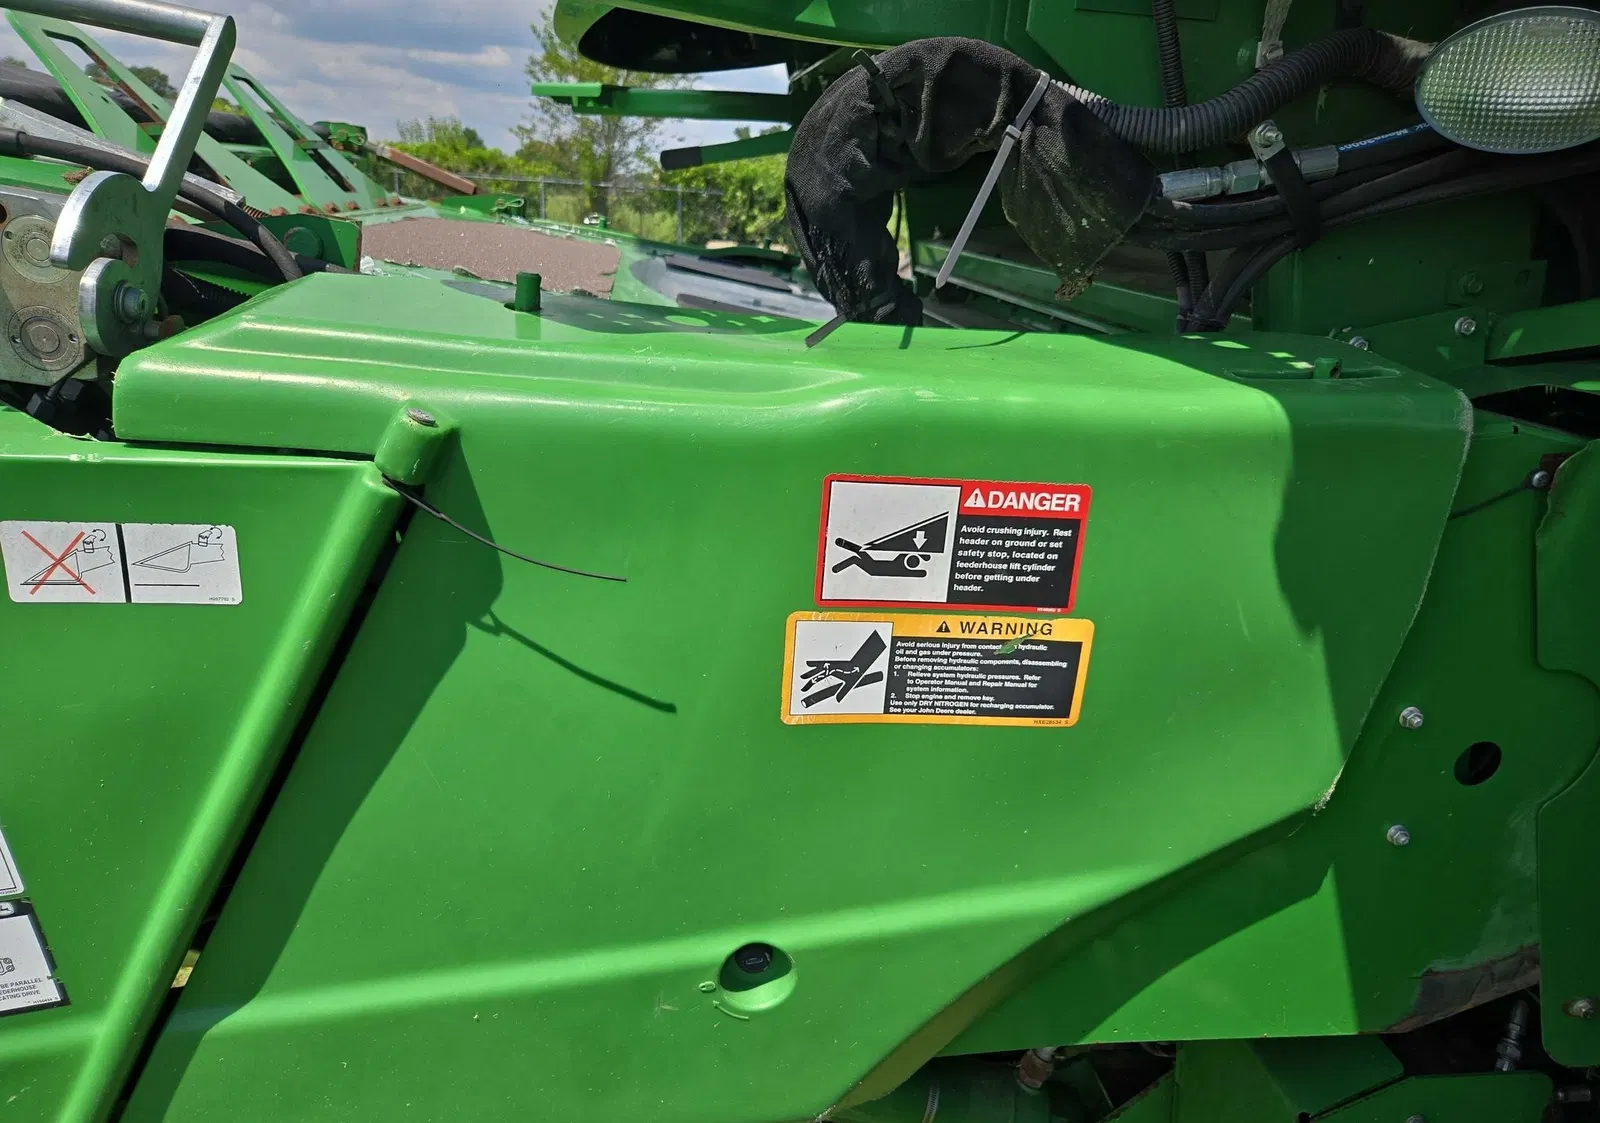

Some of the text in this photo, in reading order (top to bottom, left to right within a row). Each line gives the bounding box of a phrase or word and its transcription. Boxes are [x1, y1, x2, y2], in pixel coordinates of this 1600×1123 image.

[988, 491, 1081, 512] DANGER
[987, 526, 1021, 536] crushing
[1024, 528, 1049, 536] injury.
[1005, 540, 1036, 548] ground
[958, 549, 985, 558] safety
[988, 551, 1009, 559] stop,
[956, 561, 1007, 569] feederhouse
[1022, 563, 1056, 571] cylinder
[984, 574, 1014, 582] getting
[960, 622, 1052, 635] WARNING
[942, 642, 960, 651] injury
[1022, 659, 1067, 668] disassembling
[10, 978, 43, 987] PARALLEL
